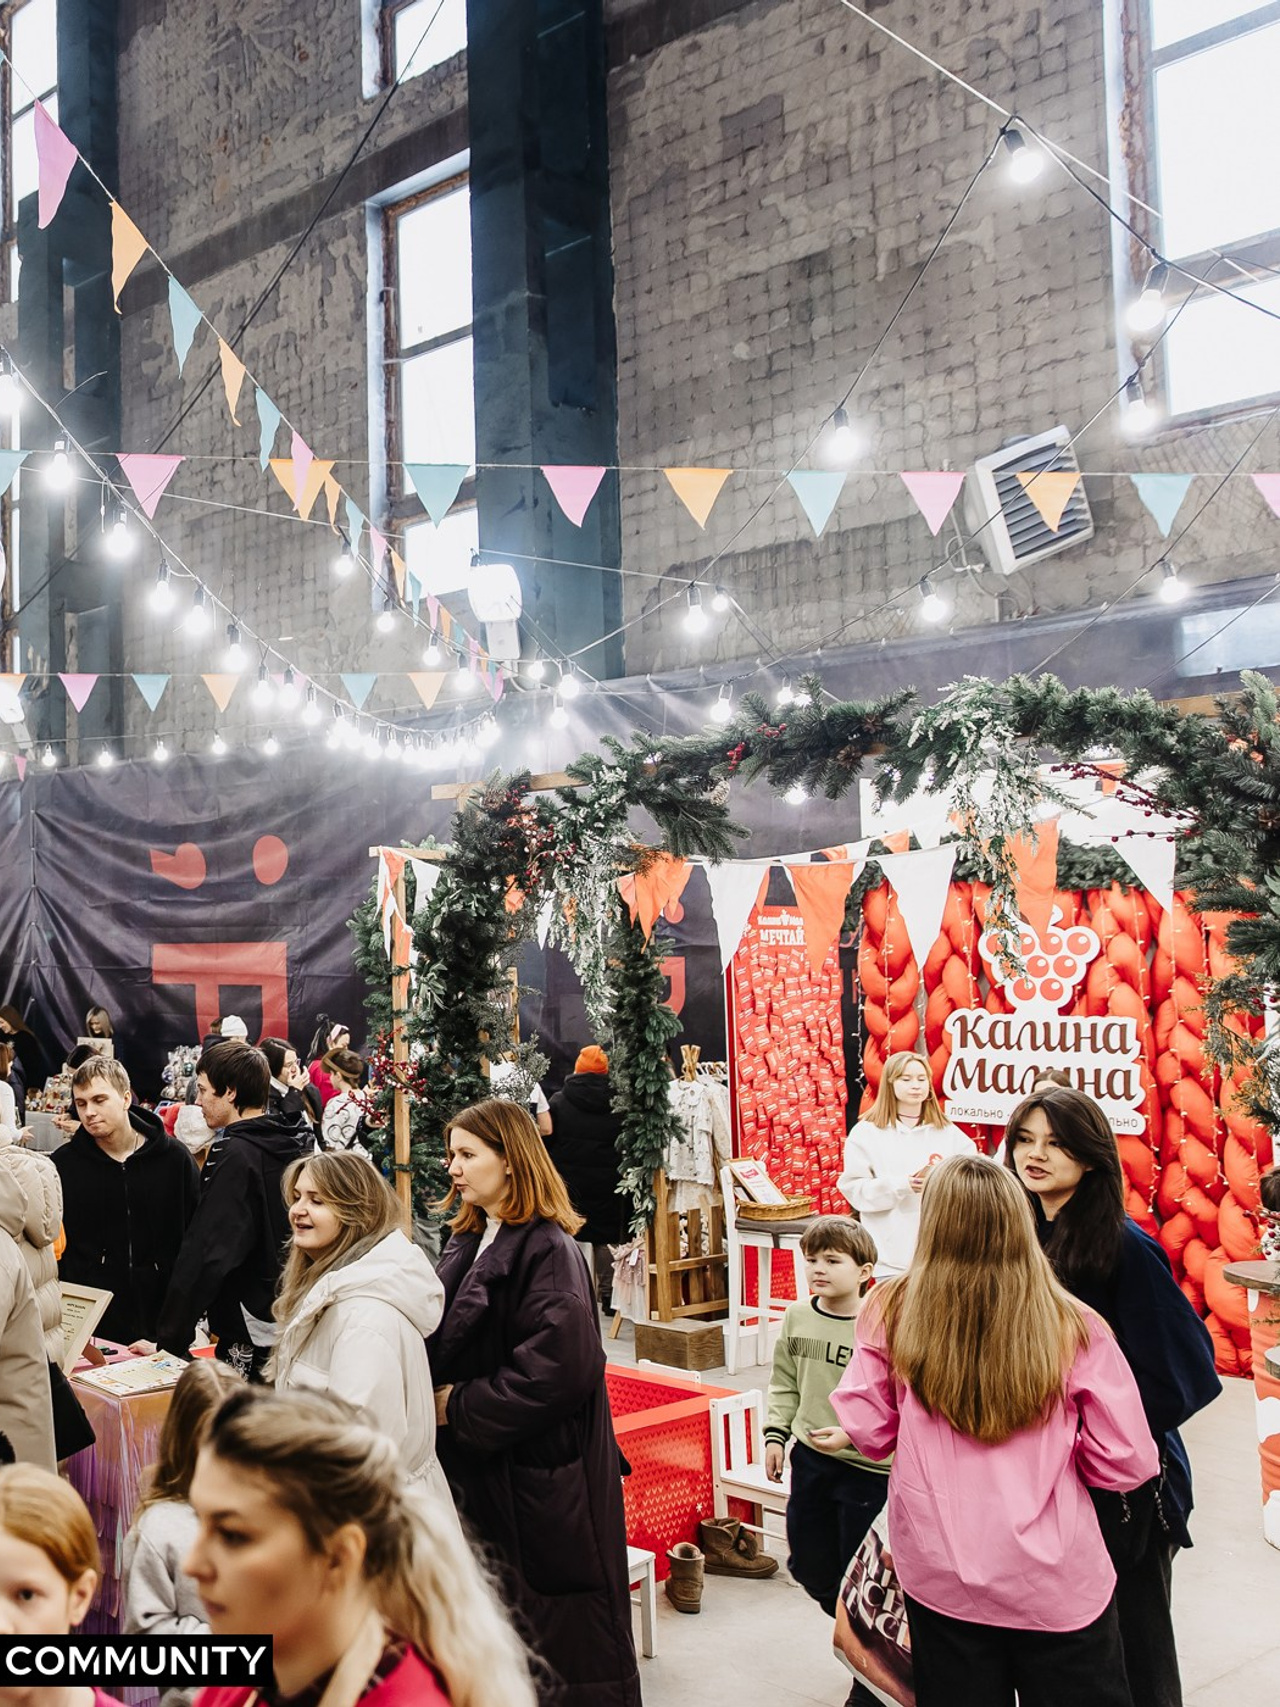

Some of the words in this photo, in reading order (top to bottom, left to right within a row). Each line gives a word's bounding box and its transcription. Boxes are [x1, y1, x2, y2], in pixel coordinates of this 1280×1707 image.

[952, 1014, 1133, 1054] Калина
[950, 1057, 1137, 1101] Мална
[950, 1106, 1003, 1119] локально
